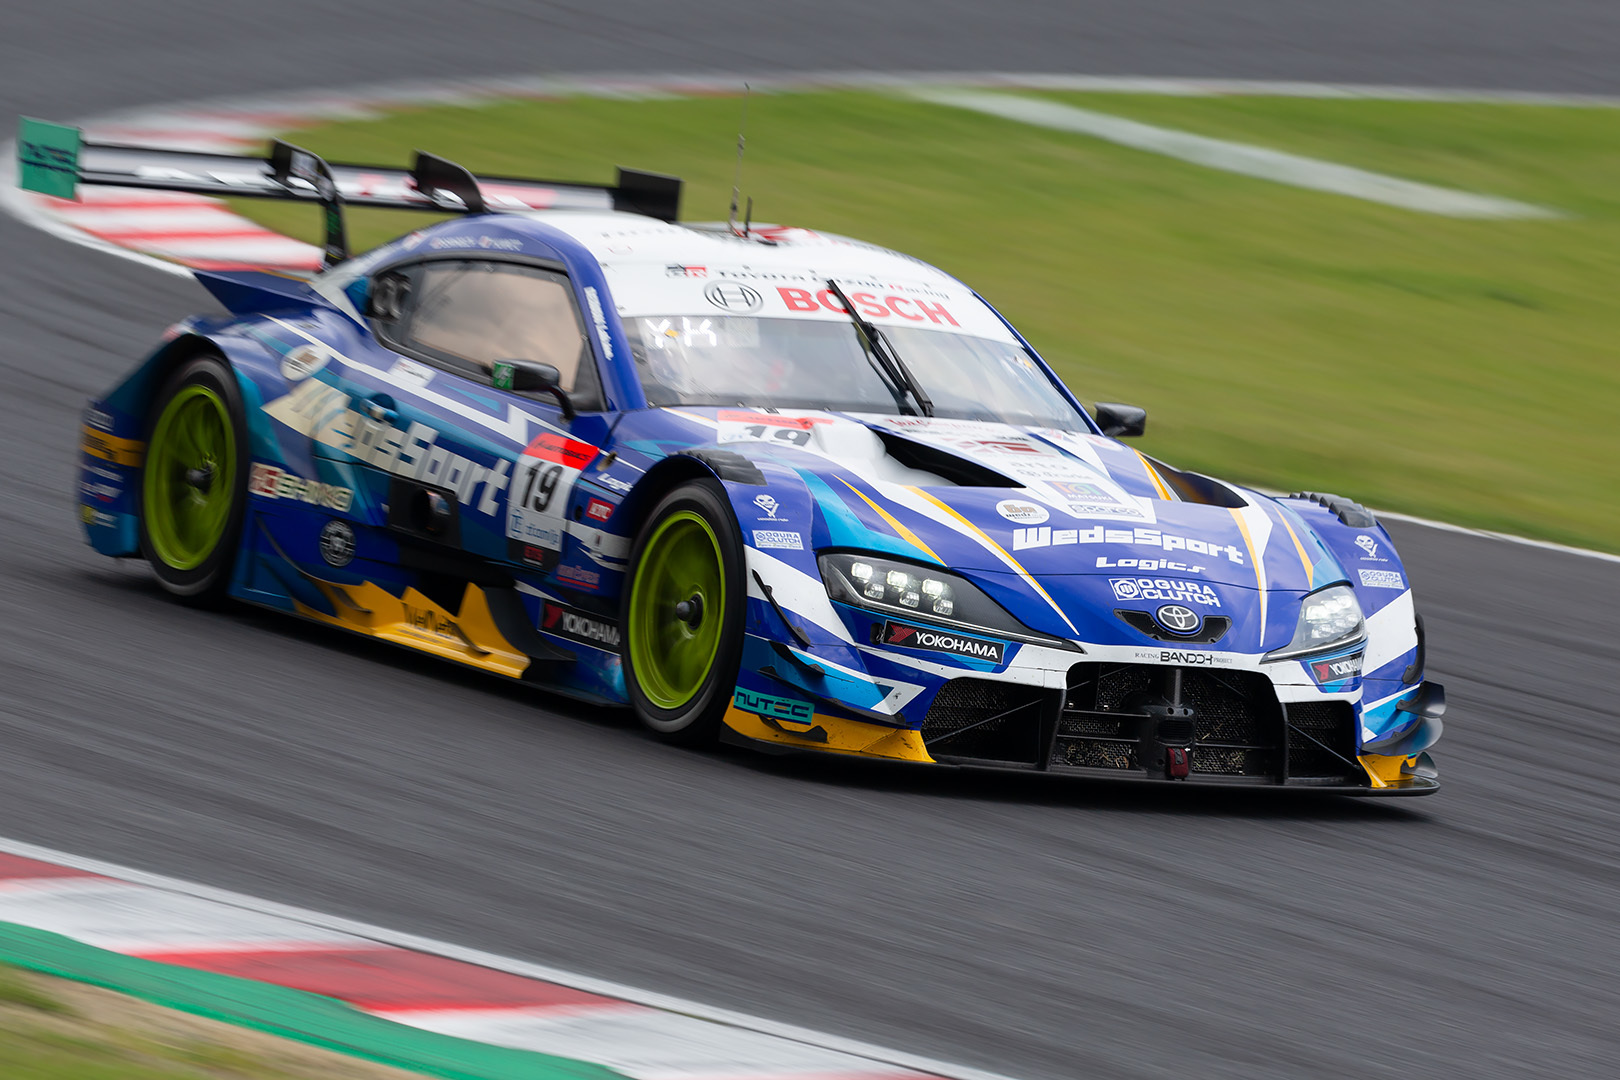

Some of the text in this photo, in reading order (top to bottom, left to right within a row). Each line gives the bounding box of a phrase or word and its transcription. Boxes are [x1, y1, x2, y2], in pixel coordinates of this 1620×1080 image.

[775, 286, 961, 328] BOSCH
[745, 425, 811, 447] 19
[521, 460, 563, 513] 19
[1012, 525, 1244, 565] WedsSport
[1096, 556, 1206, 574] Logics
[1138, 578, 1217, 598] OGURA
[1140, 588, 1221, 608] CLUTCH
[561, 611, 621, 646] YOKOHAMA
[915, 631, 999, 660] YOKOHAMA
[1135, 652, 1159, 660] RACING
[1329, 657, 1362, 676] YOKOHAM
[735, 690, 810, 719] NUTEC
